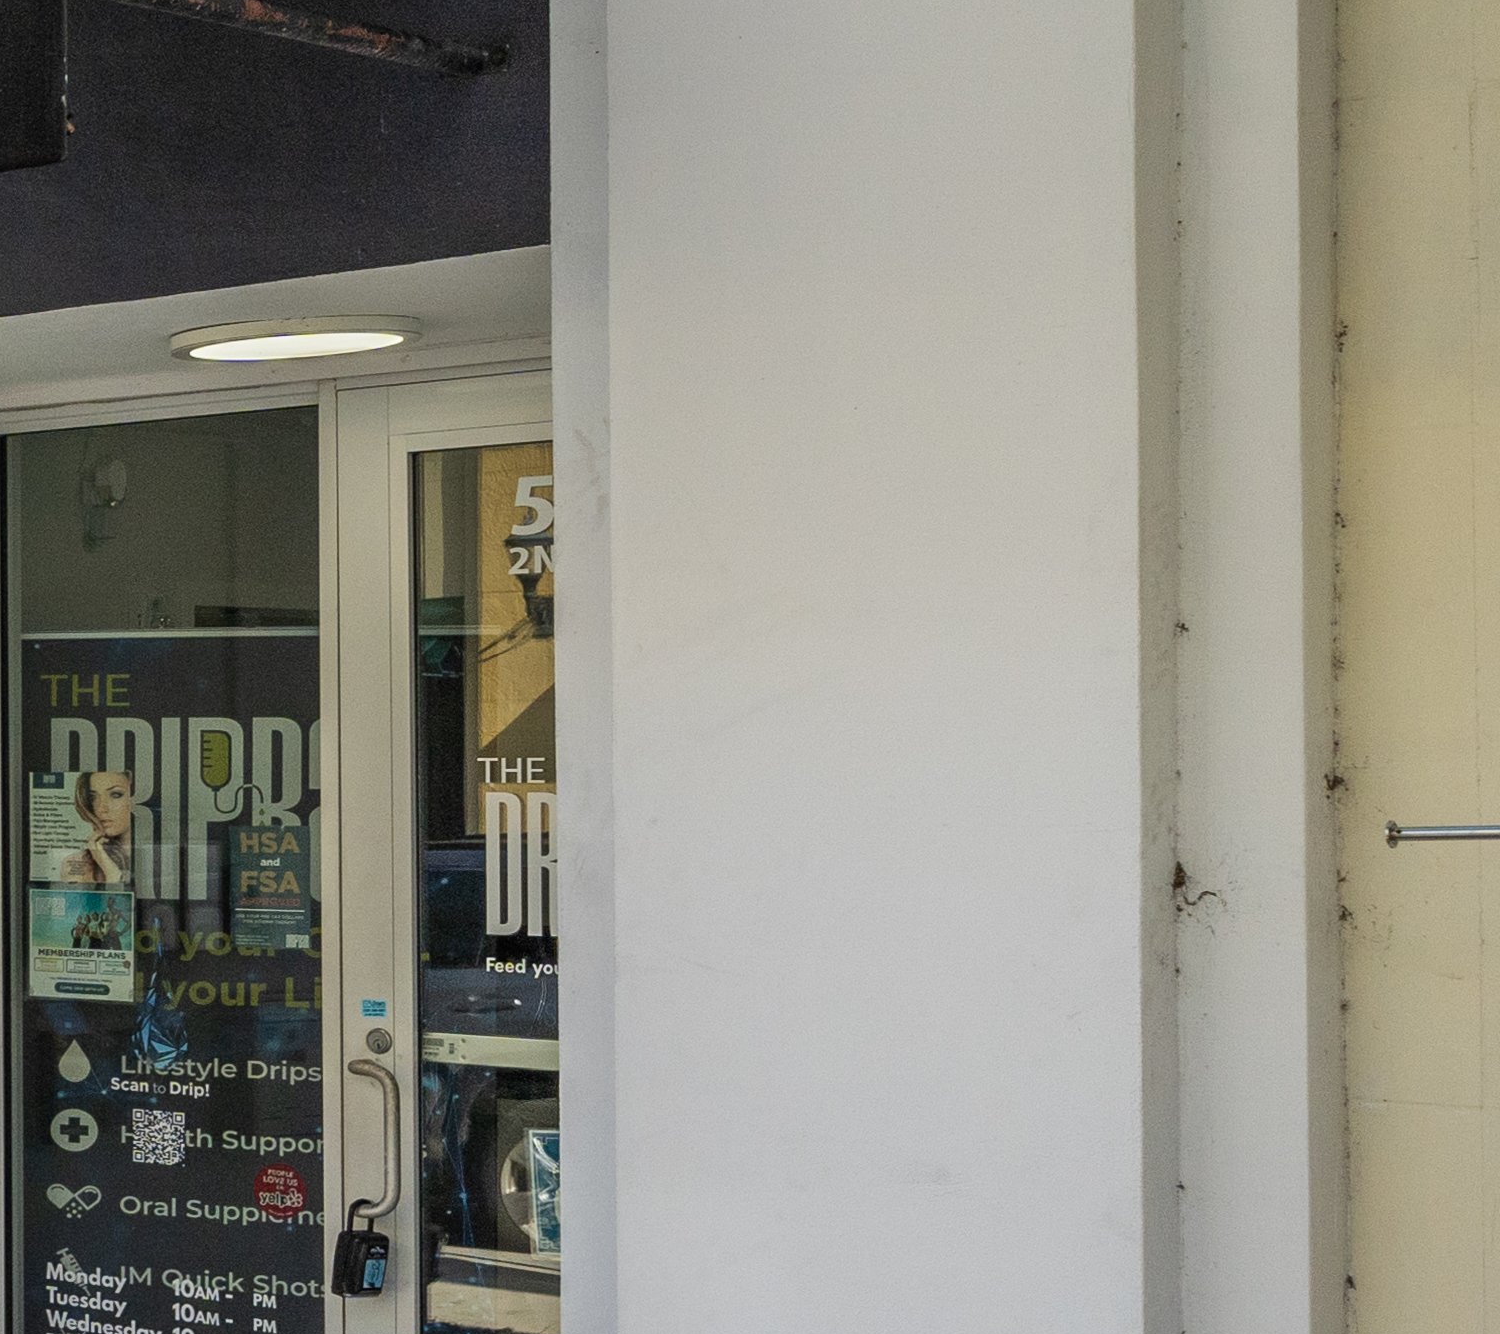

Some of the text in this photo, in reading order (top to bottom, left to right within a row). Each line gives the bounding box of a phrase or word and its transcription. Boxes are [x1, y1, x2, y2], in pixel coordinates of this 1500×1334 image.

[40, 674, 131, 707] THE
[476, 756, 545, 784] THE
[240, 832, 300, 854] HSA
[260, 857, 280, 866] and
[240, 870, 301, 893] FSA
[38, 948, 126, 960] MEMBERSHIP PLANS
[486, 957, 527, 975] Feed
[162, 980, 267, 1011] your
[247, 1060, 323, 1085] Drips
[110, 1077, 210, 1099] Scan to Drip!
[262, 1175, 298, 1186] LOVE US
[267, 1169, 294, 1178] PEOPLE
[119, 1195, 177, 1217] Oral
[259, 1192, 288, 1208] yelp
[46, 1262, 277, 1310] Monday 10AM PM
[46, 1286, 278, 1334] Tuesday 10AM PM
